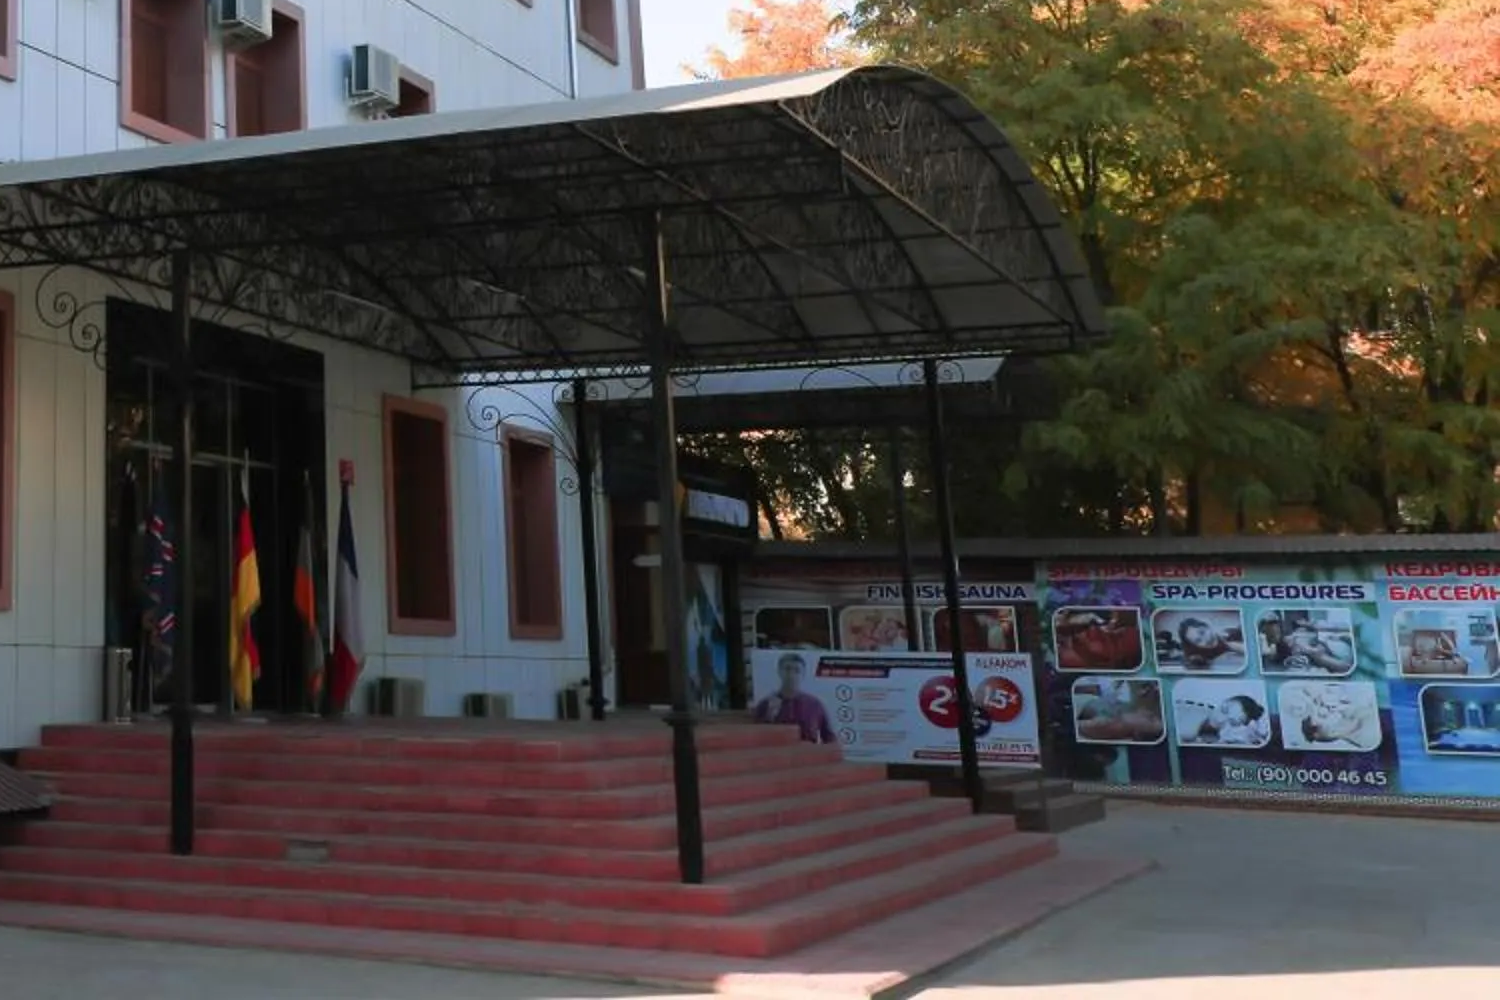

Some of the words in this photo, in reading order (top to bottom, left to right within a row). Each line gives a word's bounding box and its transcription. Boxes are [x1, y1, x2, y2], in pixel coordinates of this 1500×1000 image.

[866, 584, 946, 599] FINISH
[955, 584, 1027, 599] SAUNA
[1152, 584, 1365, 600] SPA-PROCEDURES
[1256, 764, 1293, 785] (90)
[1296, 768, 1333, 783] 000
[1338, 769, 1361, 784] 46
[1364, 770, 1388, 786] 45
